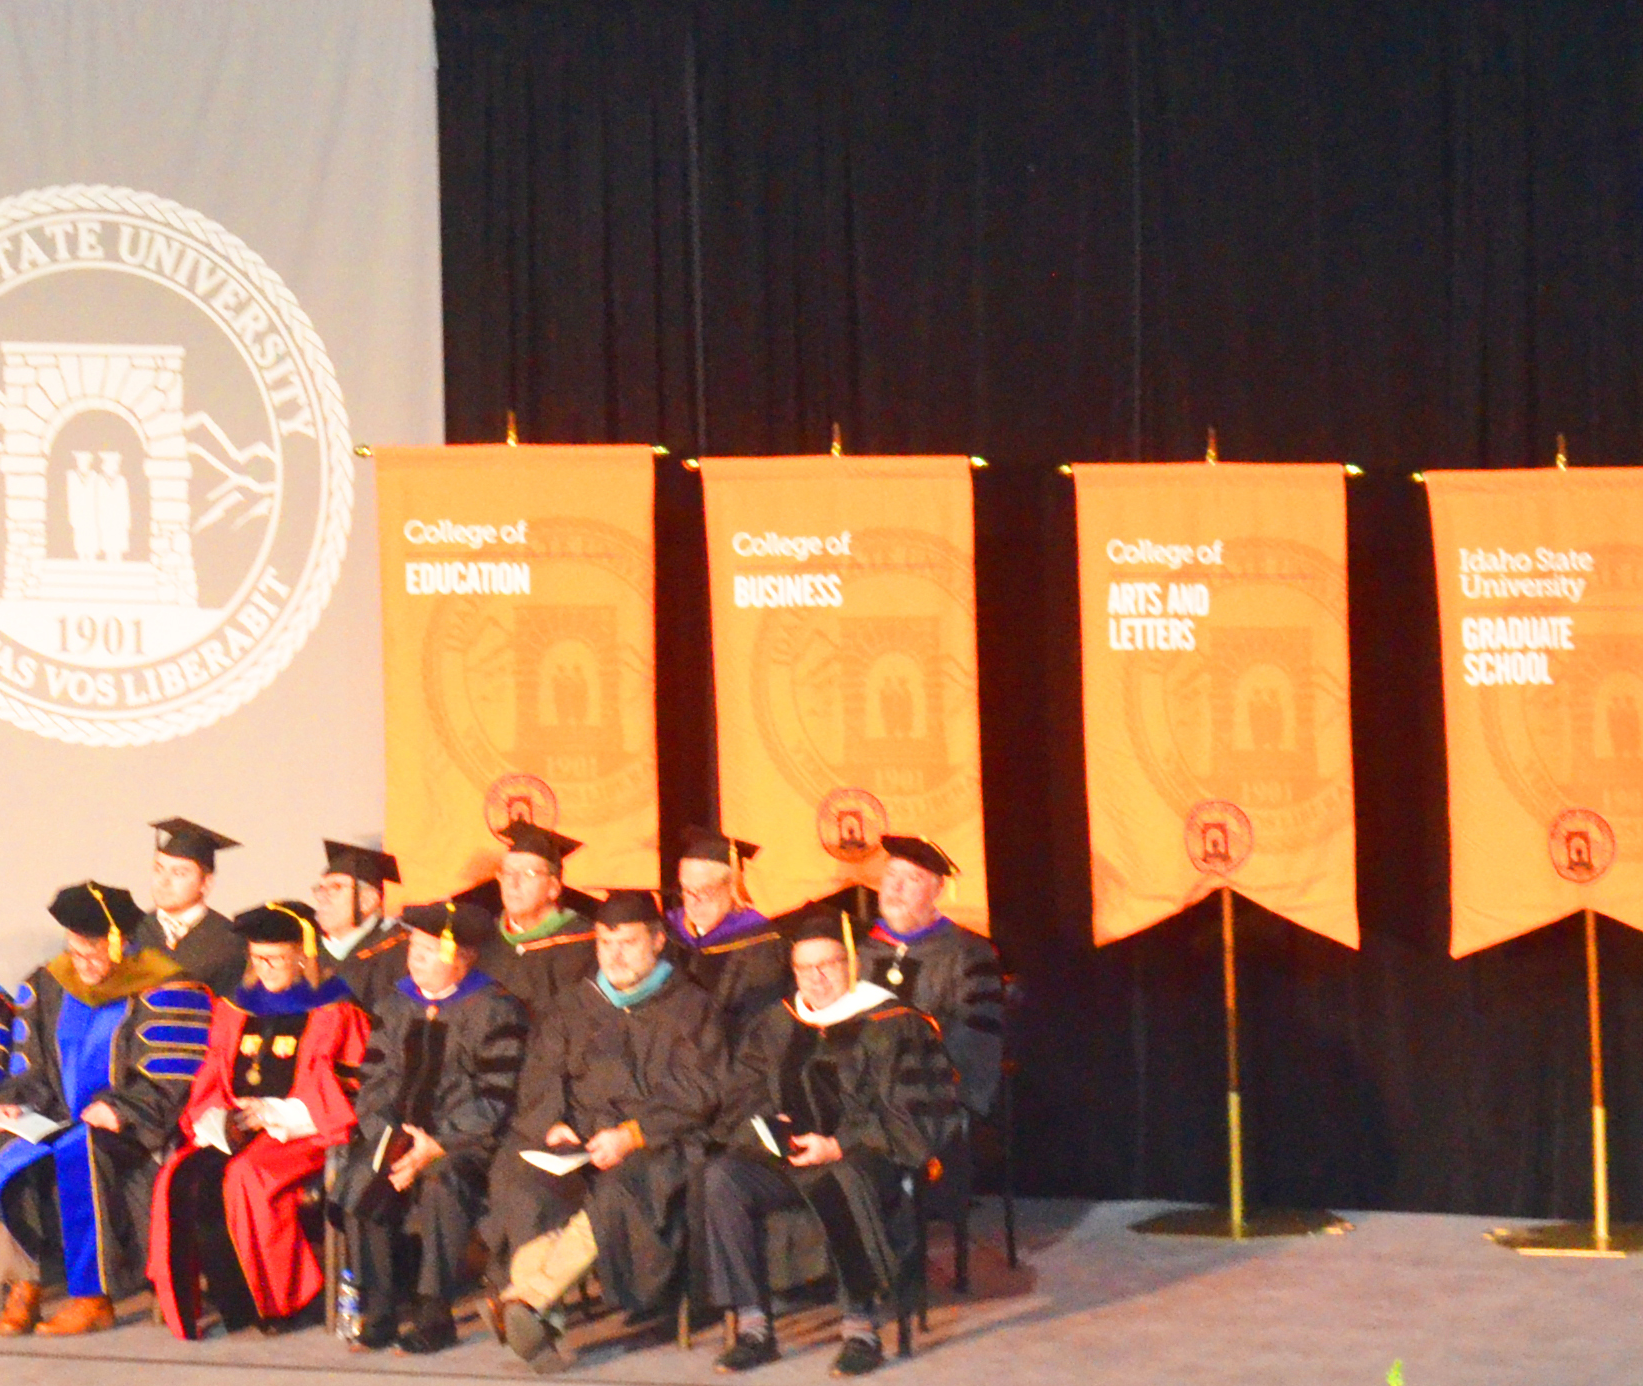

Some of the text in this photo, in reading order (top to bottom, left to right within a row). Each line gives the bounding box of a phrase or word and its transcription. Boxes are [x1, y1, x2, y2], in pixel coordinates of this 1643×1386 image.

[119, 224, 317, 439] UNIVERSITY
[404, 519, 528, 549] College of
[732, 530, 852, 561] College of
[1106, 539, 1224, 569] College of
[1459, 547, 1594, 572] Idaho State
[405, 562, 531, 595] EDUCATION
[733, 574, 843, 608] BUSINESS
[1460, 574, 1587, 603] University
[1108, 582, 1210, 617] ARTS AND
[43, 664, 115, 706] VOS
[121, 566, 290, 707] LIBERABIT
[56, 615, 148, 657] 1901
[1109, 617, 1196, 651] LETTERS
[1462, 616, 1574, 651] GRADUATE
[1464, 651, 1554, 686] SCHOOL
